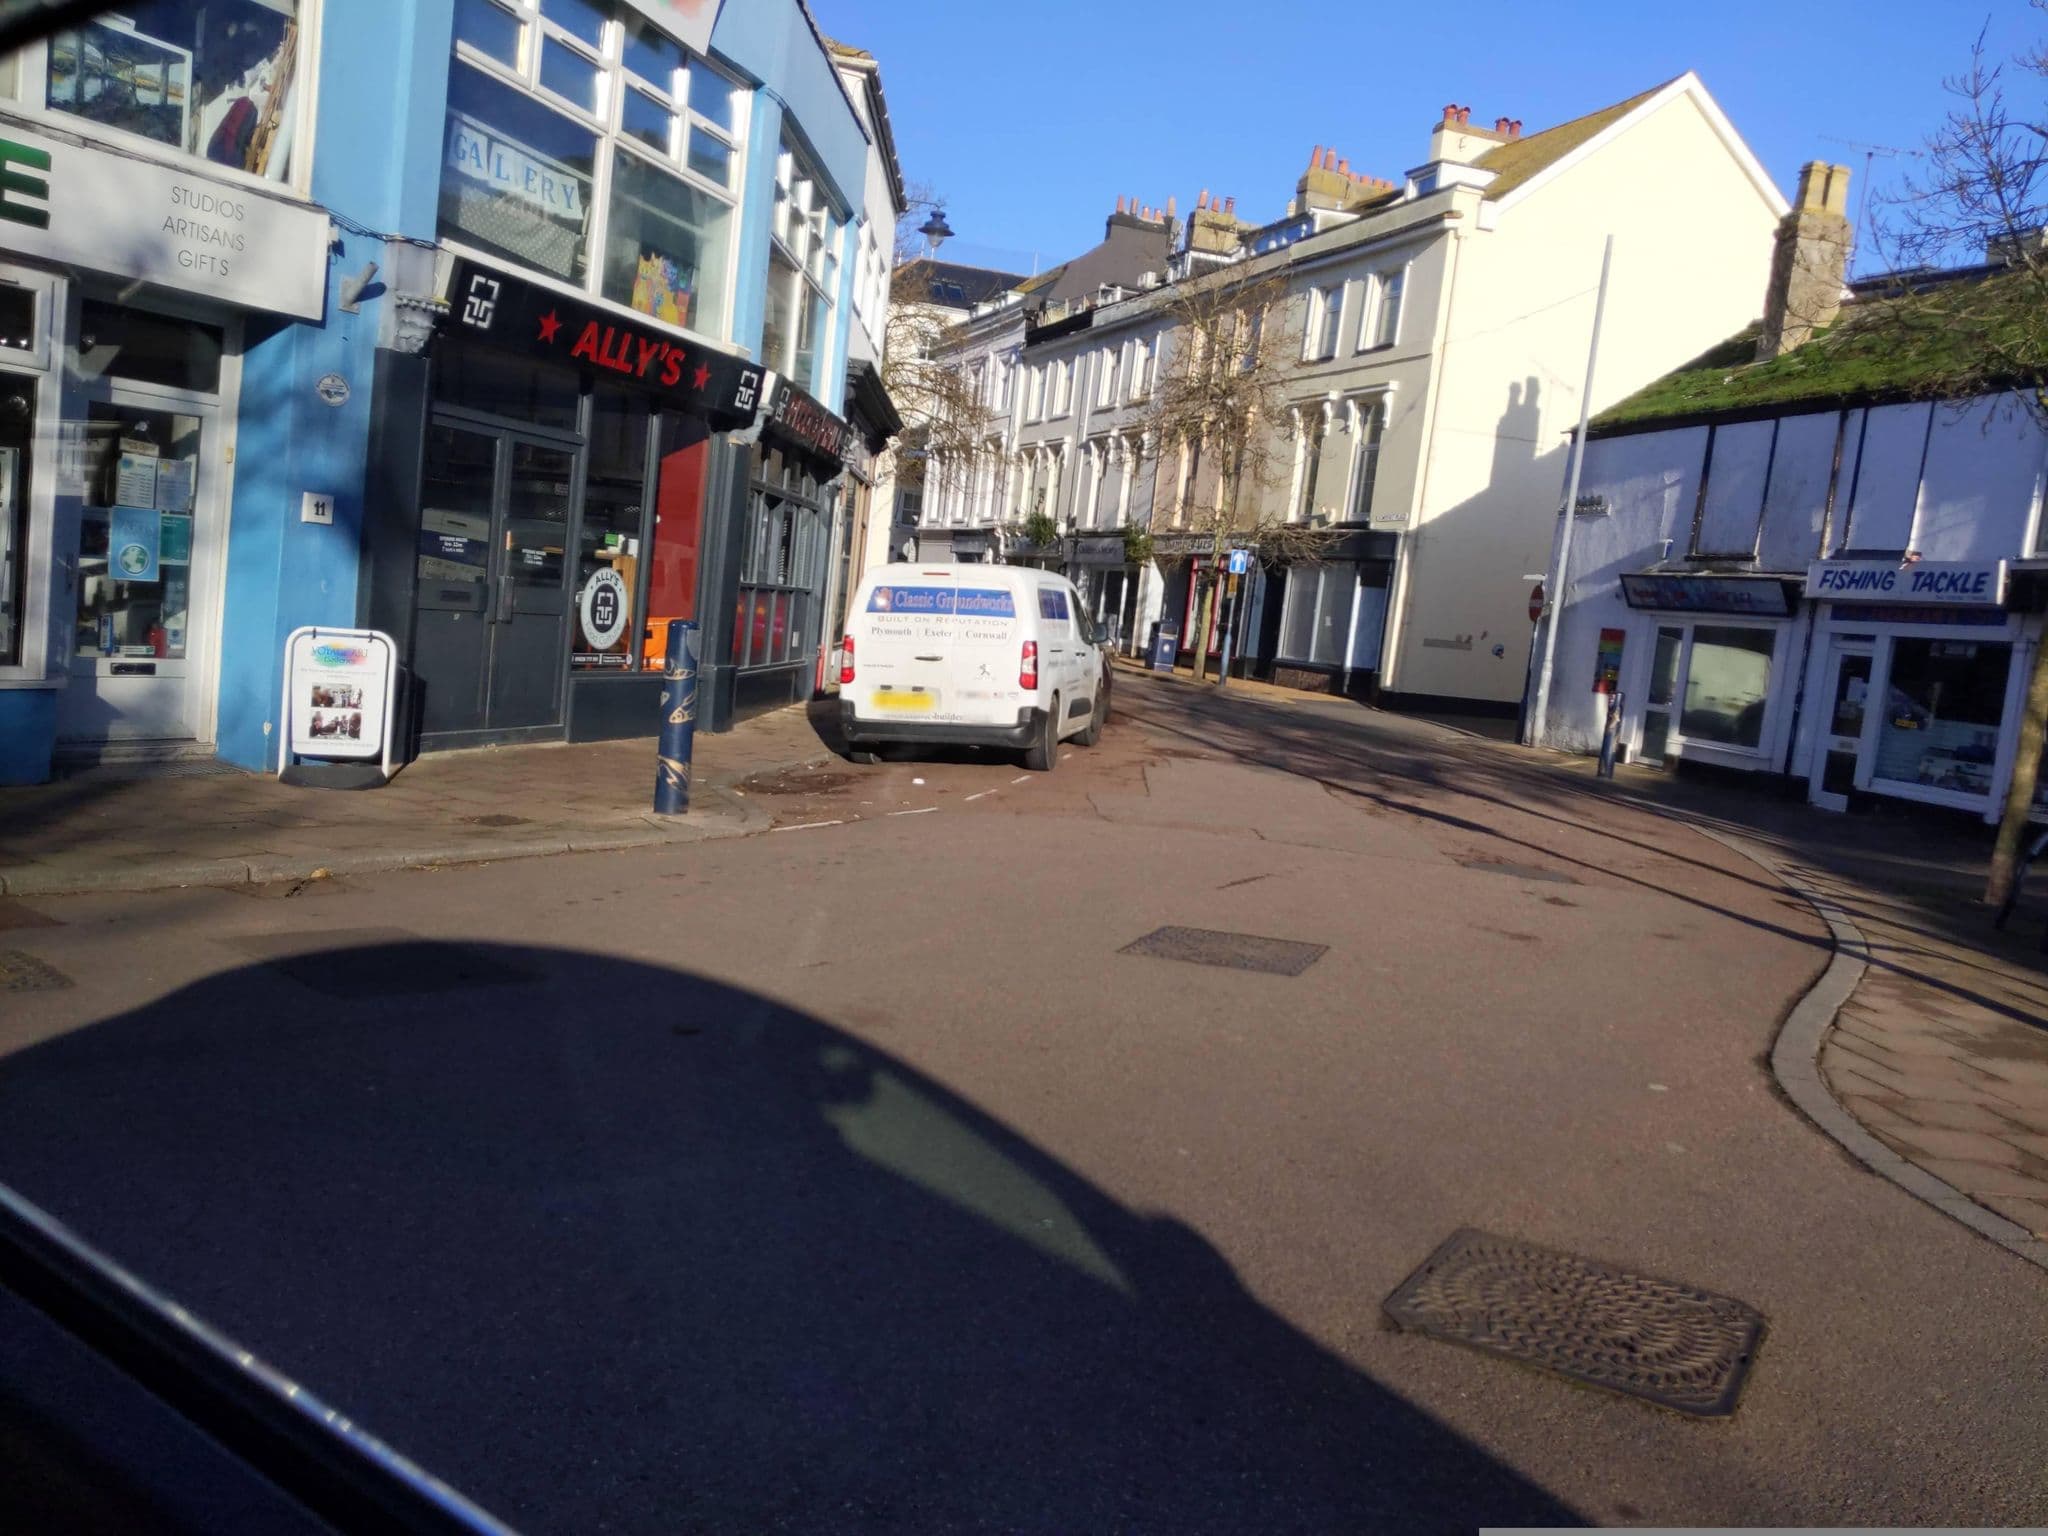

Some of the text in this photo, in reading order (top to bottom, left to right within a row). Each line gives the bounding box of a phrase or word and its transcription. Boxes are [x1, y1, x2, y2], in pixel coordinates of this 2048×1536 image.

[171, 185, 244, 221] STUDIOS
[162, 215, 245, 252] ARTISANS
[177, 249, 229, 276] GIFTS
[570, 320, 686, 386] ALLY'S
[313, 500, 326, 516] 11
[595, 571, 620, 587] ALLY'S
[1818, 569, 1990, 594] FISHING TACKLE
[895, 590, 934, 609] Classic
[871, 626, 1008, 640] Plymouth Exeter Cornwall
